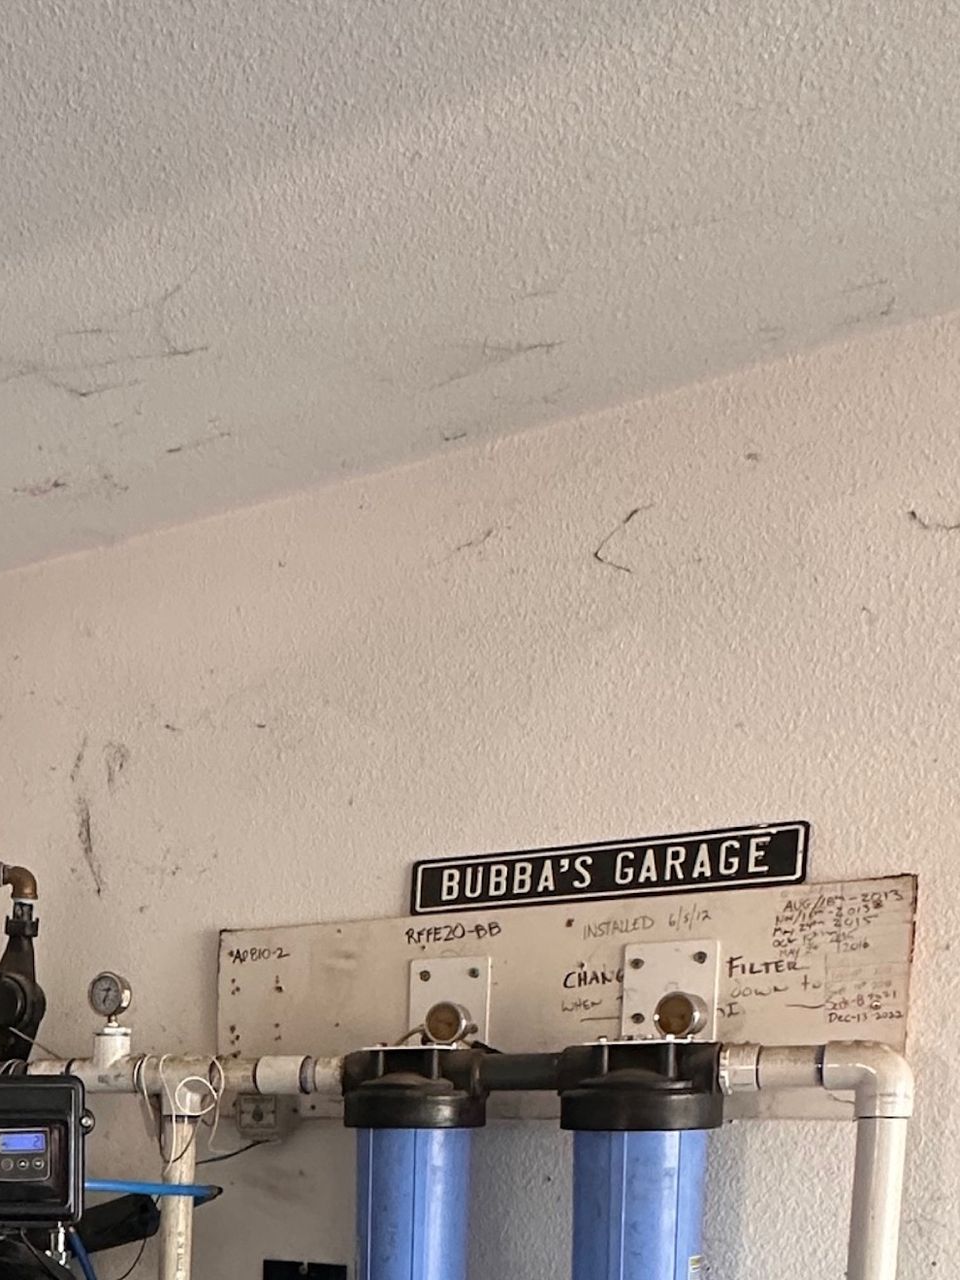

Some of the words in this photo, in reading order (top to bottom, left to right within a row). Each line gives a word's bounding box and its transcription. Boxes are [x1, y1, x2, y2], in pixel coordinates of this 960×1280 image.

[441, 854, 593, 901] BUBBA'S
[615, 836, 772, 884] GARAGE
[405, 921, 502, 944] RFFE20-BB
[583, 917, 655, 940] INSTALLED
[563, 970, 625, 988] CHANG
[727, 956, 809, 977] FILTER
